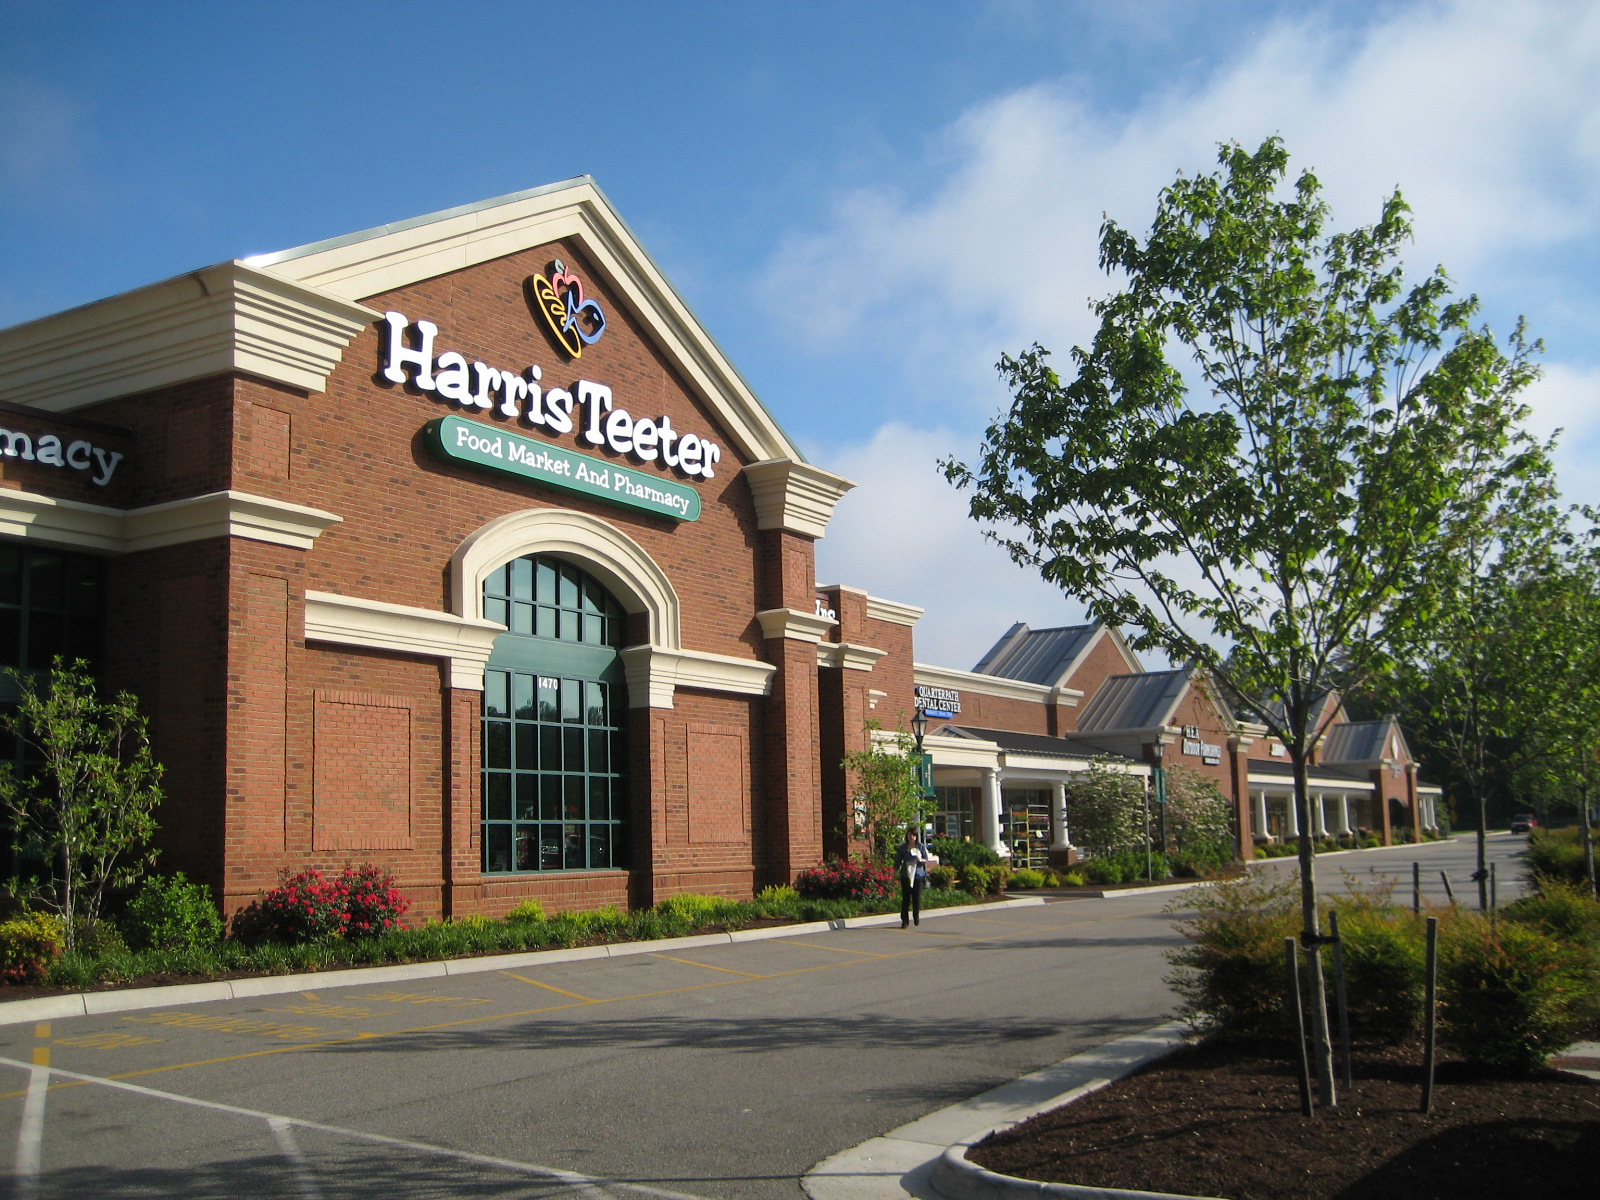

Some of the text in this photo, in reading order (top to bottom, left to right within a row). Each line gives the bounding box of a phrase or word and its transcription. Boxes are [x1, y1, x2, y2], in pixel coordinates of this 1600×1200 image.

[384, 311, 721, 479] Harris Teeter
[456, 426, 690, 516] Food Market And Pharmacy
[538, 677, 559, 690] 1470
[919, 686, 959, 701] QUARTERPATH
[914, 697, 961, 713] DENTAL CENTER
